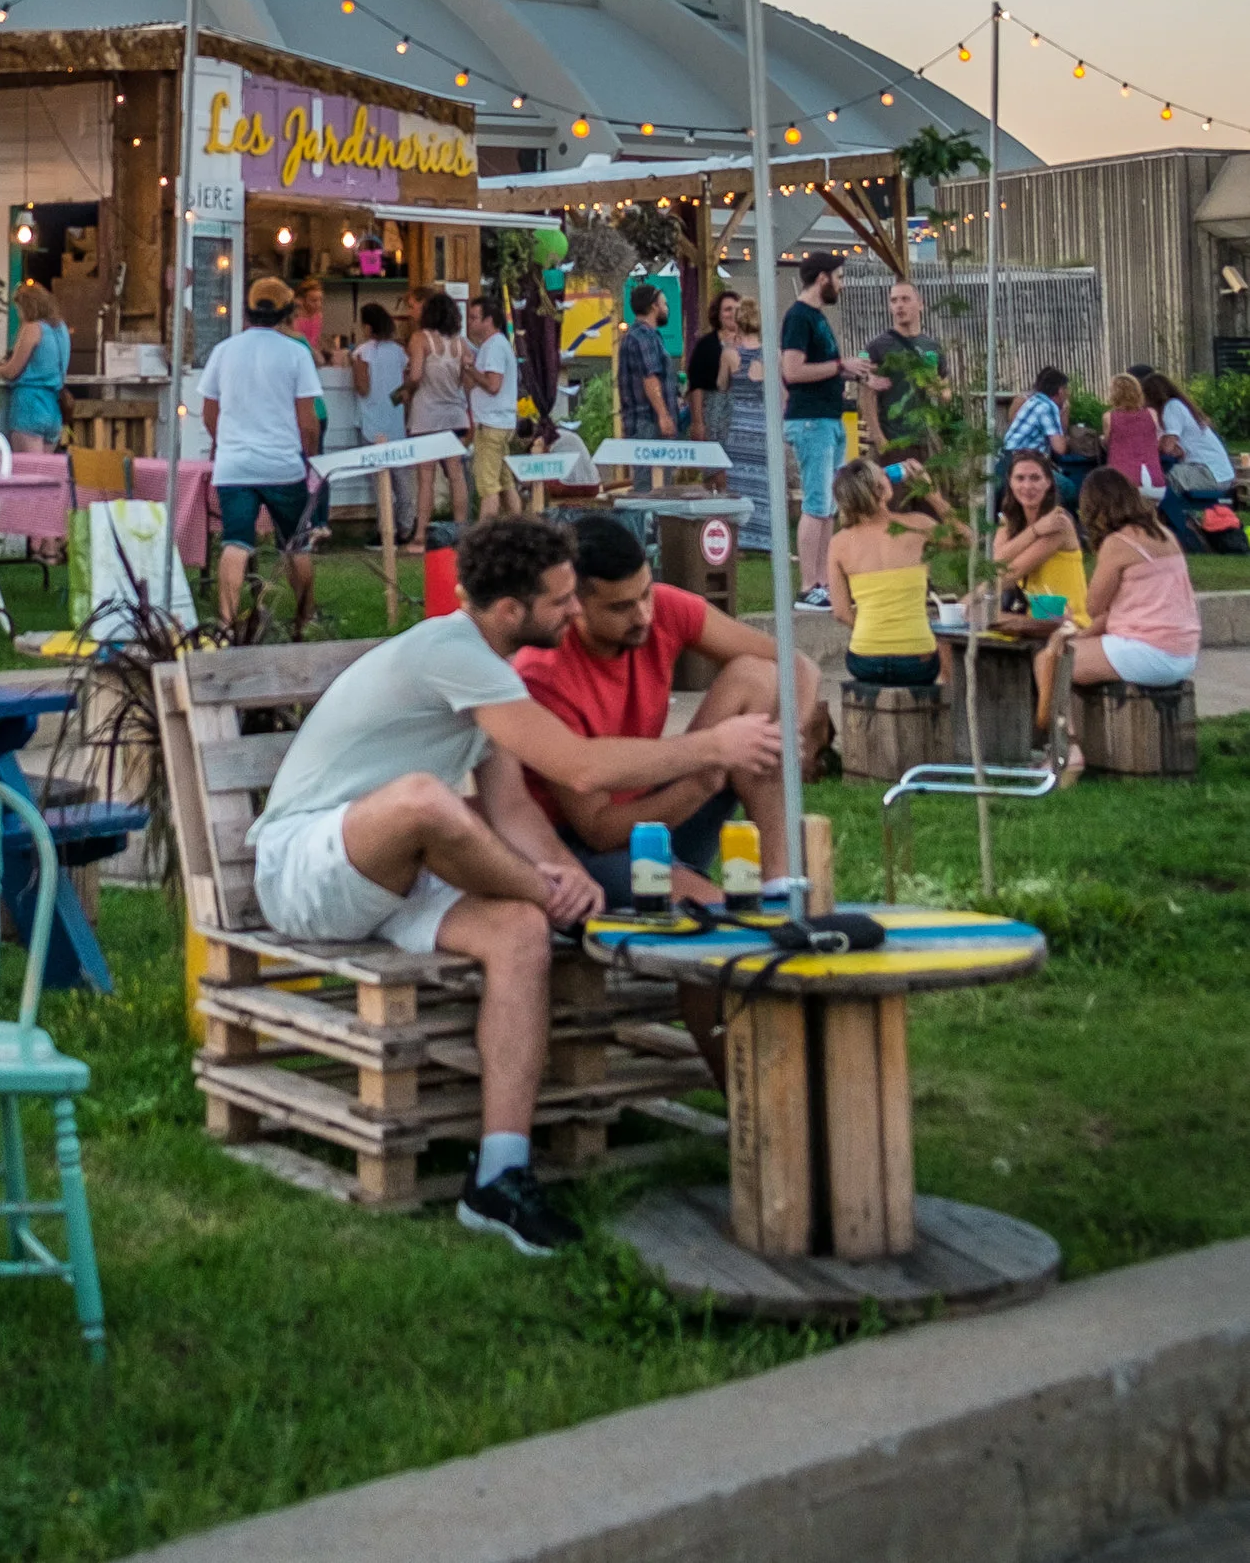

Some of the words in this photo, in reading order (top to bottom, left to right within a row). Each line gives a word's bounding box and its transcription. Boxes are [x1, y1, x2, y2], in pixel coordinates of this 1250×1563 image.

[205, 92, 273, 155] Les
[283, 105, 474, 187] Jardineries
[633, 446, 697, 461] COMPOSTE
